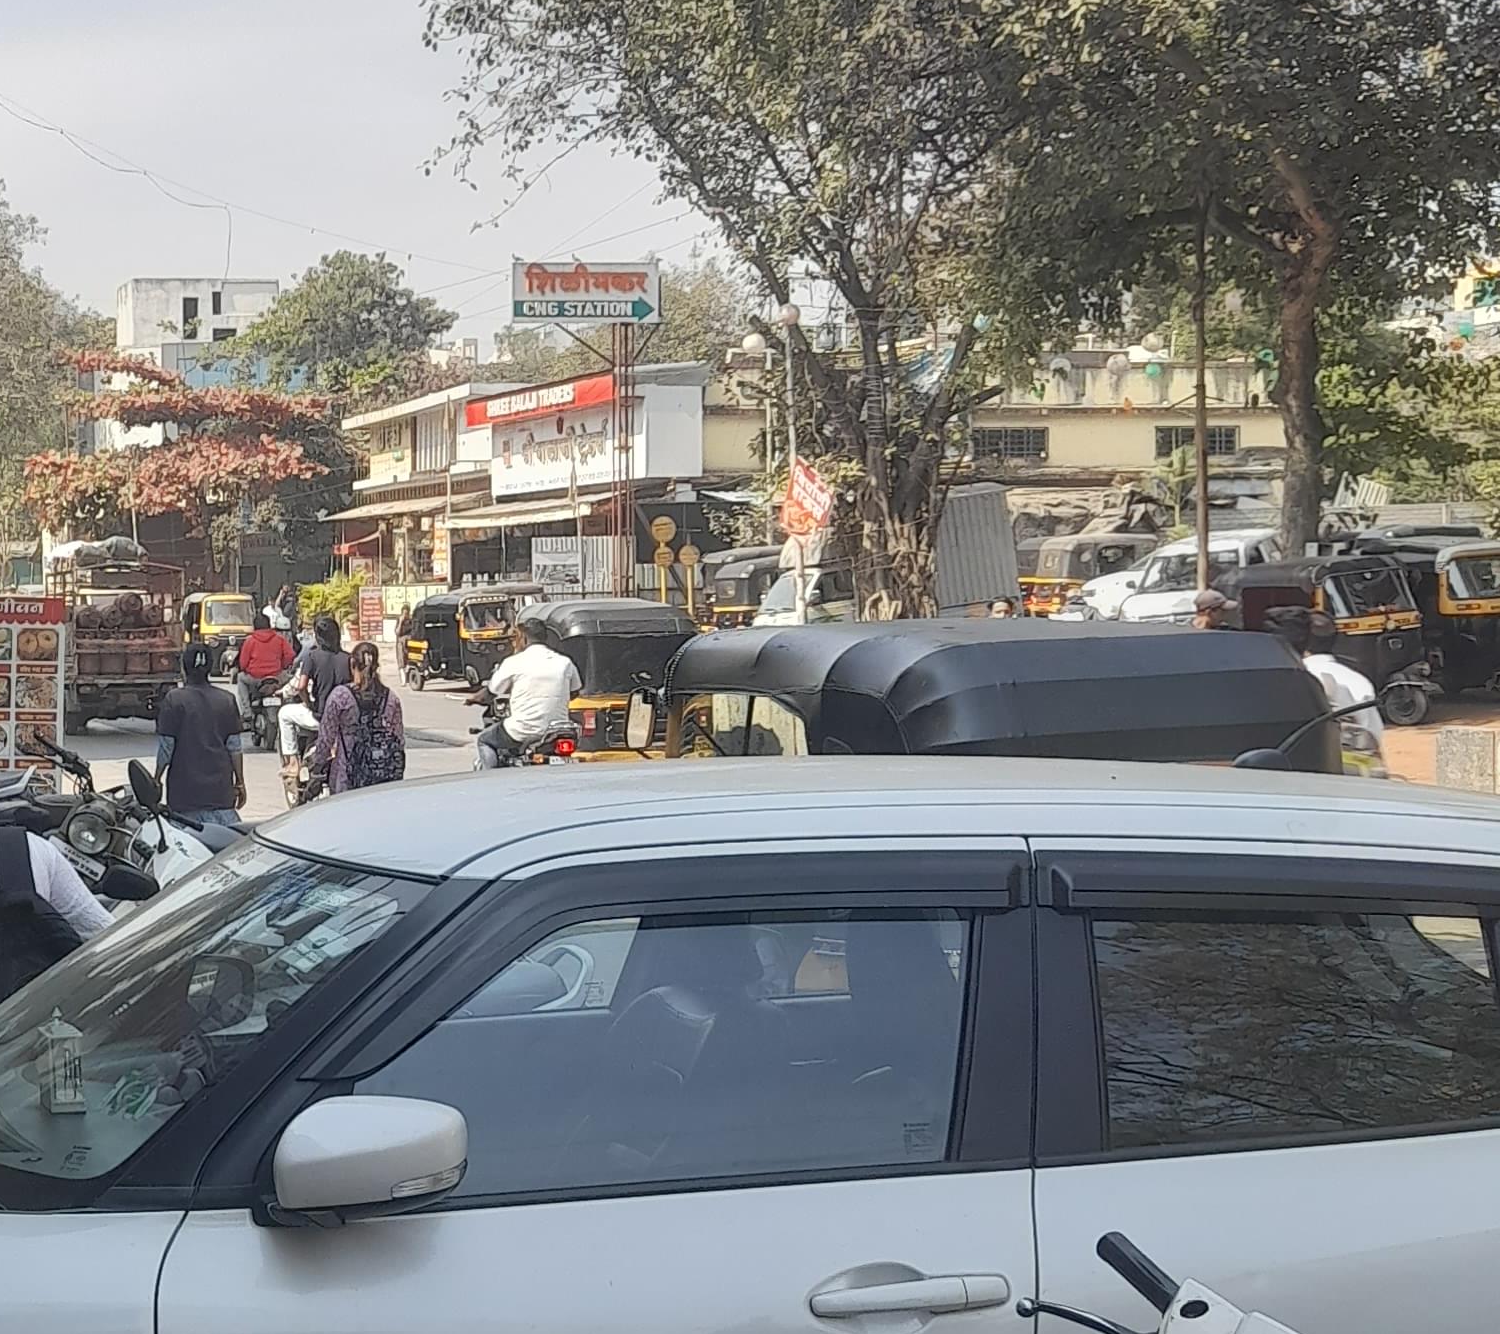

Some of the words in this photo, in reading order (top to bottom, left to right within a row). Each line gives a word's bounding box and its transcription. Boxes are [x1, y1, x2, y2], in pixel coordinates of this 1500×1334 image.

[522, 301, 560, 317] CNG
[563, 301, 634, 317] STATION
[539, 383, 576, 405] TRADERS
